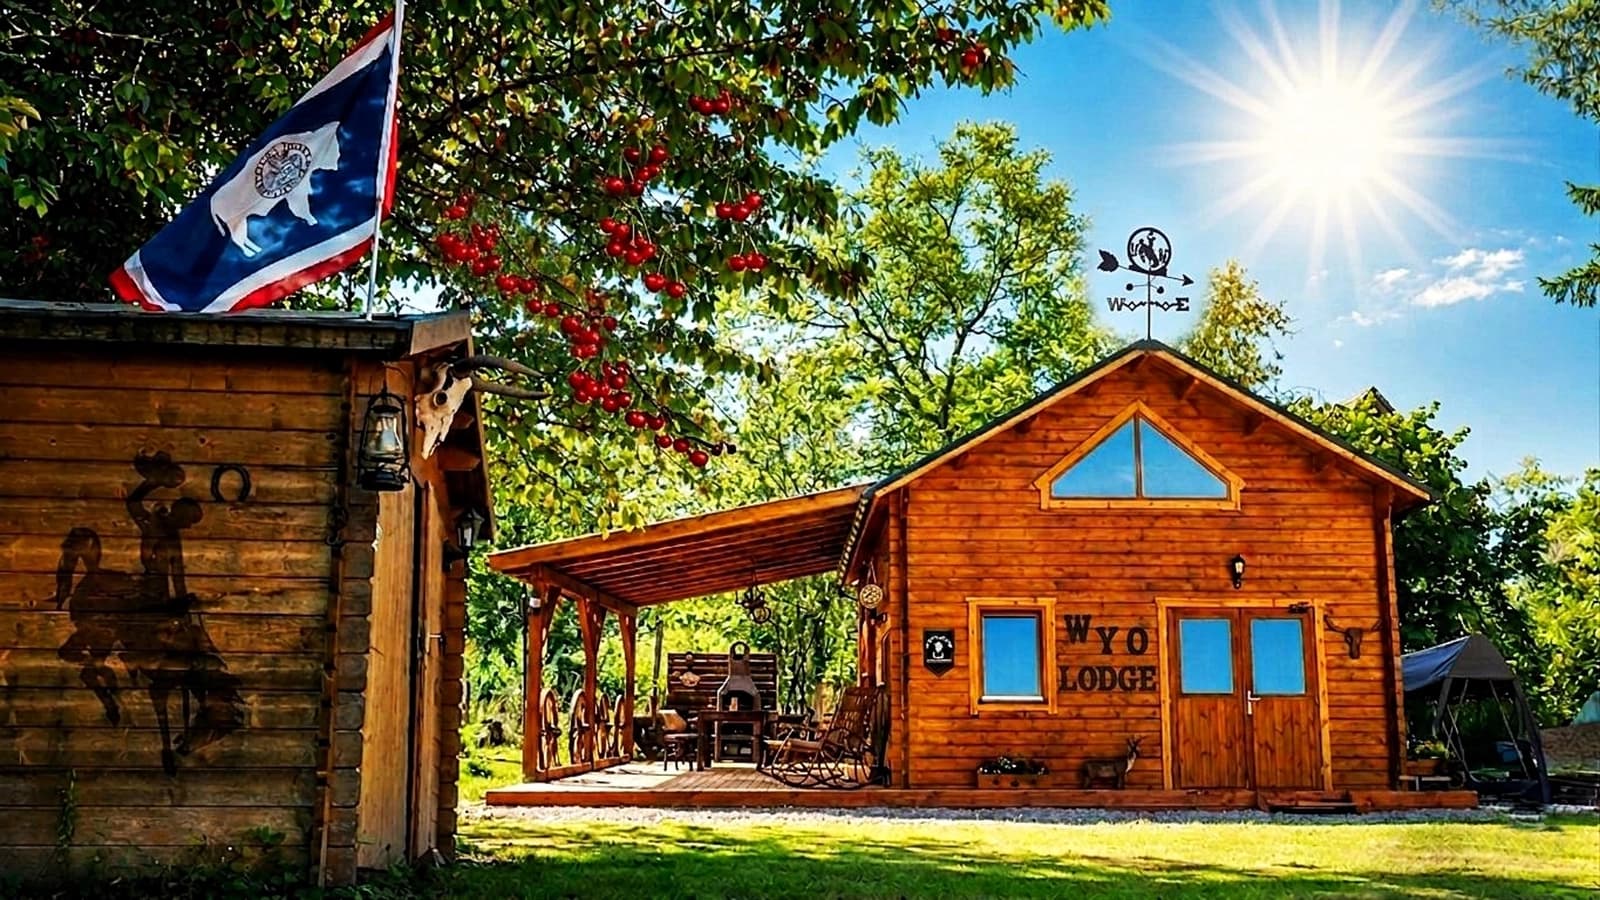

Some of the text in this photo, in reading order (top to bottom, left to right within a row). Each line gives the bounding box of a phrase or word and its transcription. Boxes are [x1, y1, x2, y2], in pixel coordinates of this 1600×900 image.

[1106, 297, 1190, 312] W E
[1064, 614, 1149, 655] WYO
[1059, 666, 1157, 692] LODGE
